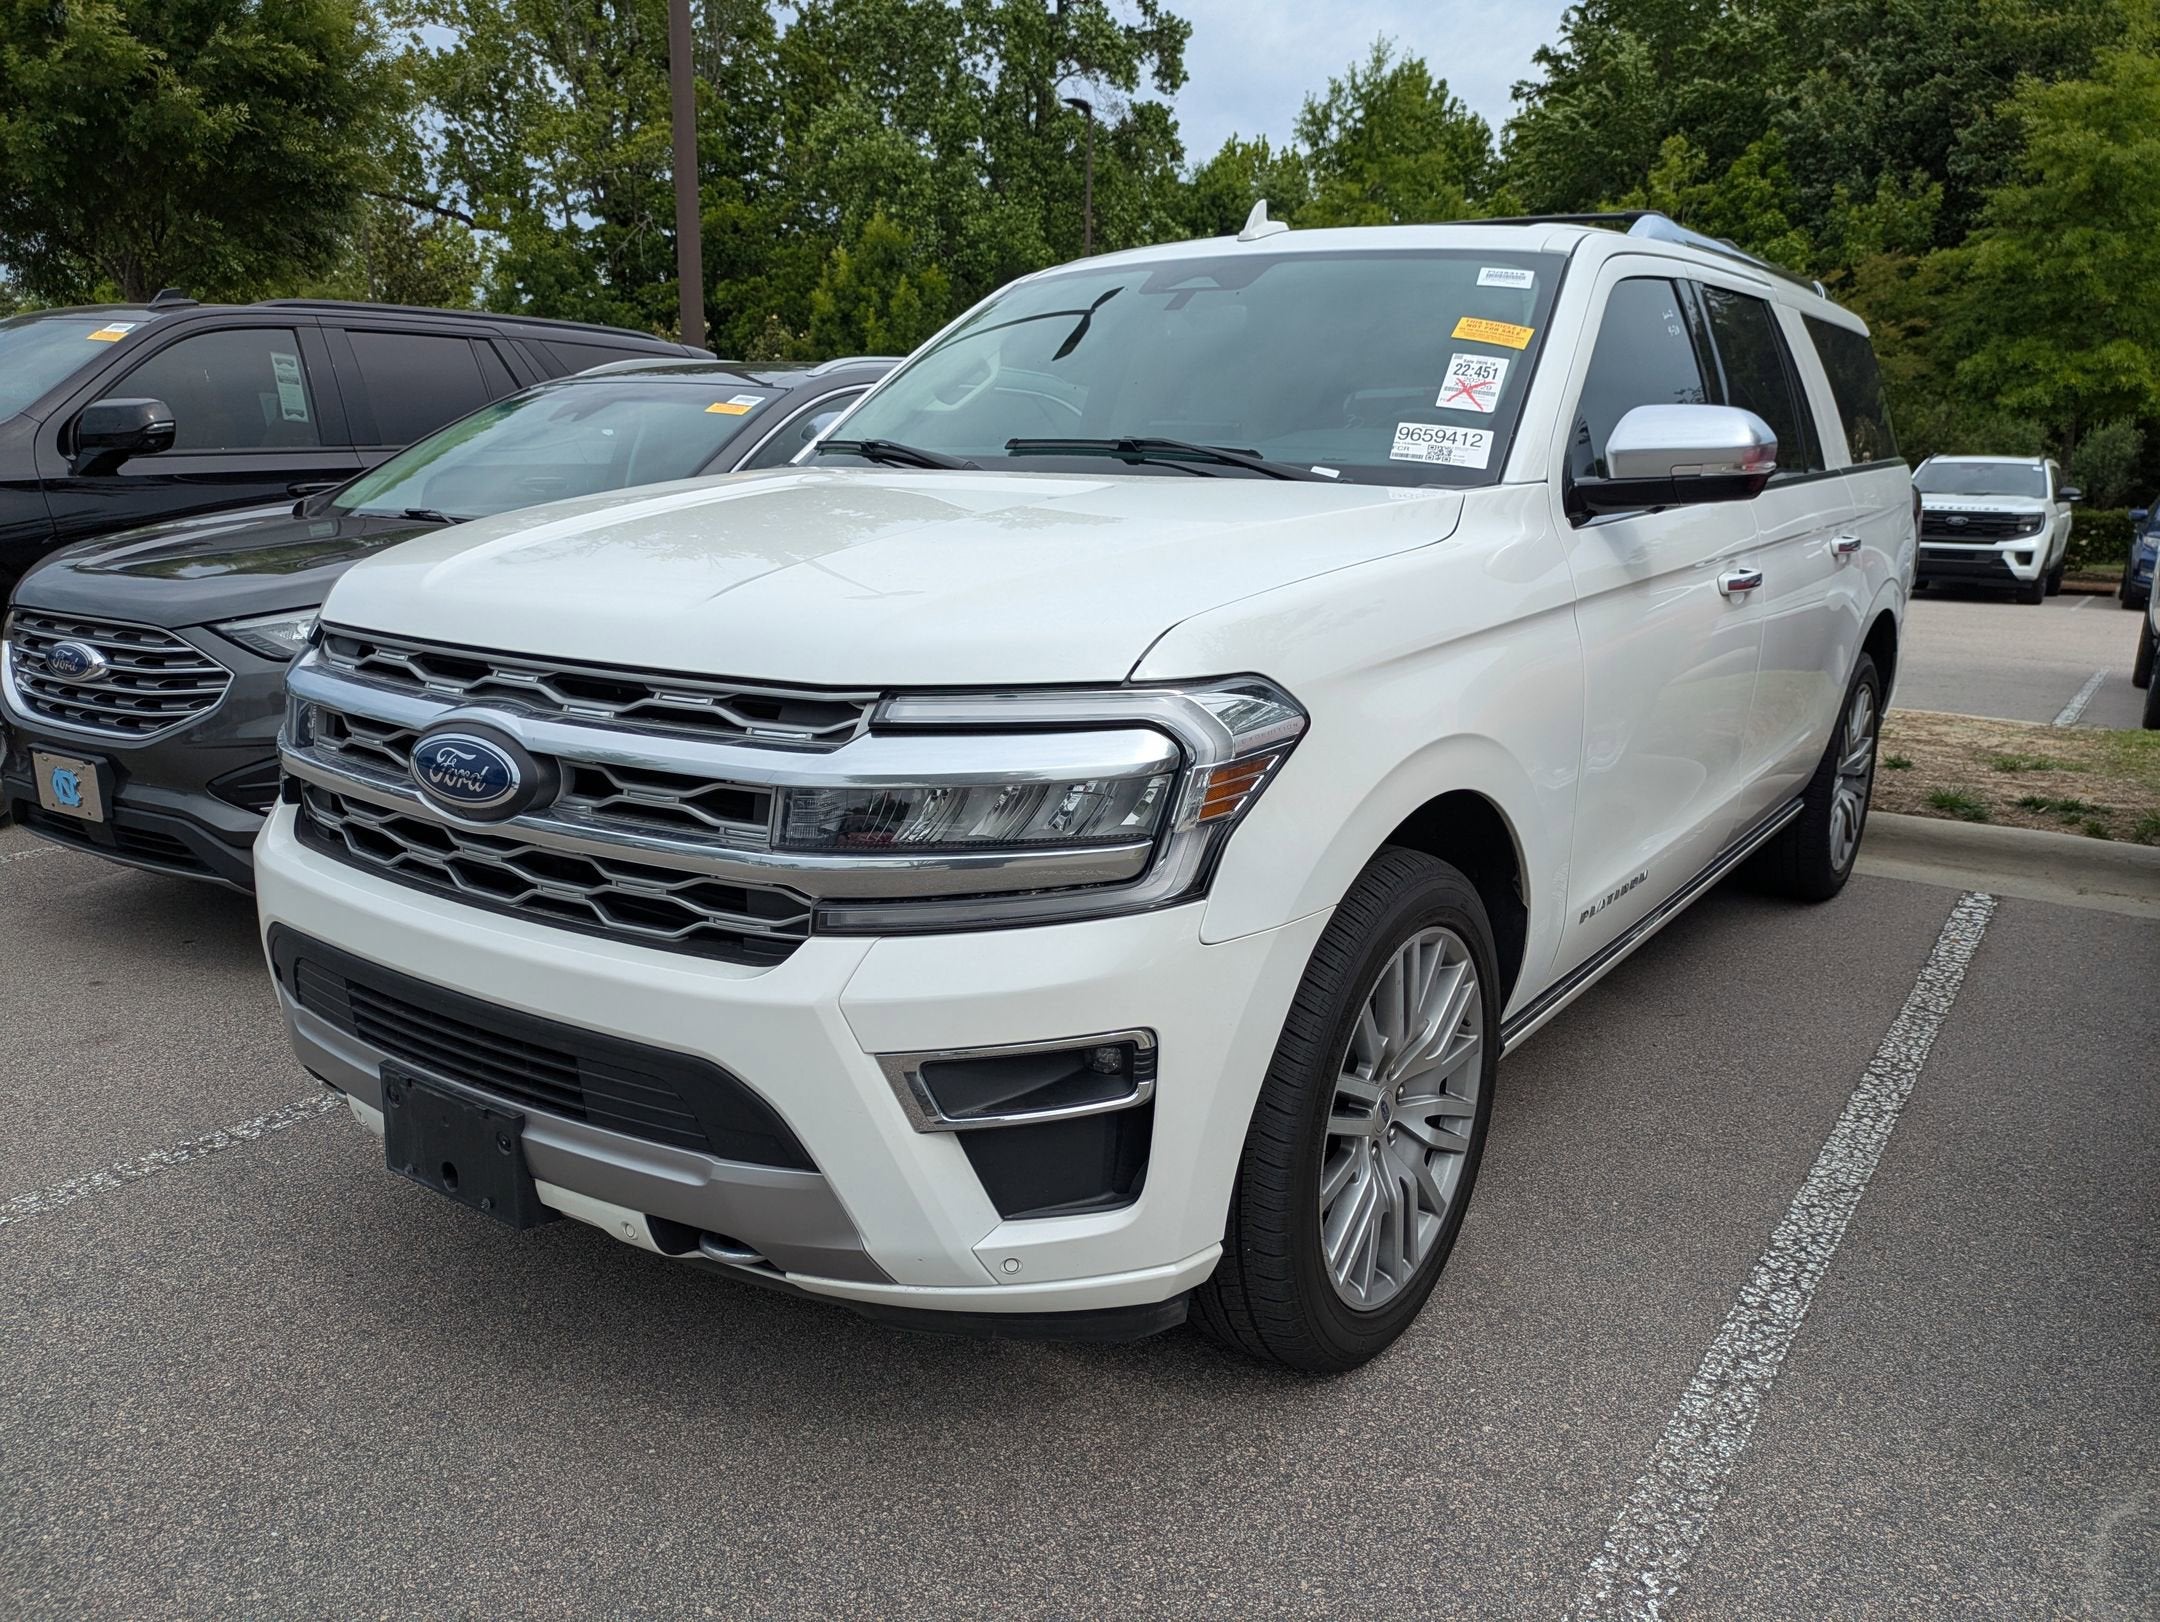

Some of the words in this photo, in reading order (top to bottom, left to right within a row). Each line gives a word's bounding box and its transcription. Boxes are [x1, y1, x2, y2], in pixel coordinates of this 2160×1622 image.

[1453, 362, 1499, 380] 22:451
[1397, 426, 1484, 448] 9659412
[52, 649, 79, 672] Ford
[429, 746, 490, 793] Ford
